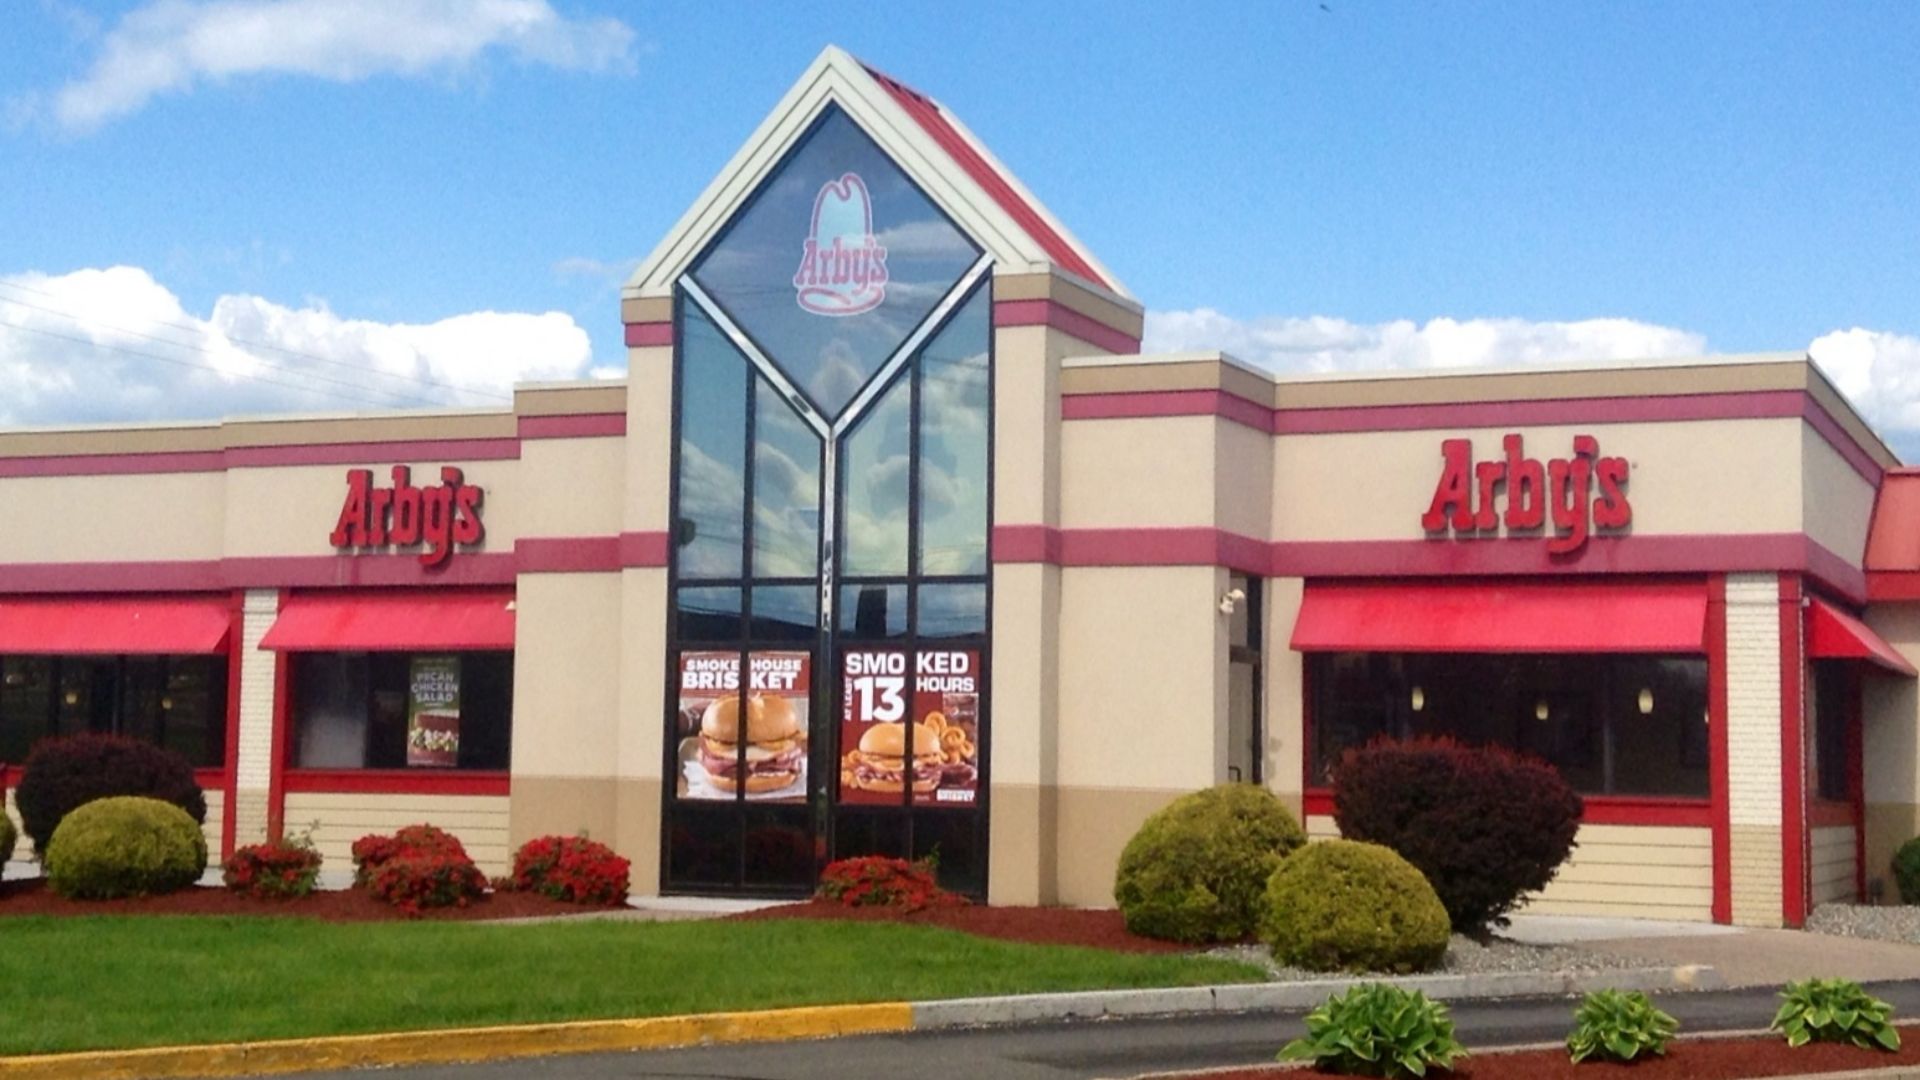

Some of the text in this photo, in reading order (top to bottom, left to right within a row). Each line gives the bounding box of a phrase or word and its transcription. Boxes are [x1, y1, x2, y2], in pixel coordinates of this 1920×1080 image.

[794, 236, 887, 295] Arby's
[330, 465, 485, 568] Arby's
[1422, 434, 1632, 554] Arby's
[411, 682, 459, 693] CHICKEN
[416, 692, 454, 703] SALAD
[853, 676, 905, 722] 13
[915, 676, 975, 692] HOURS
